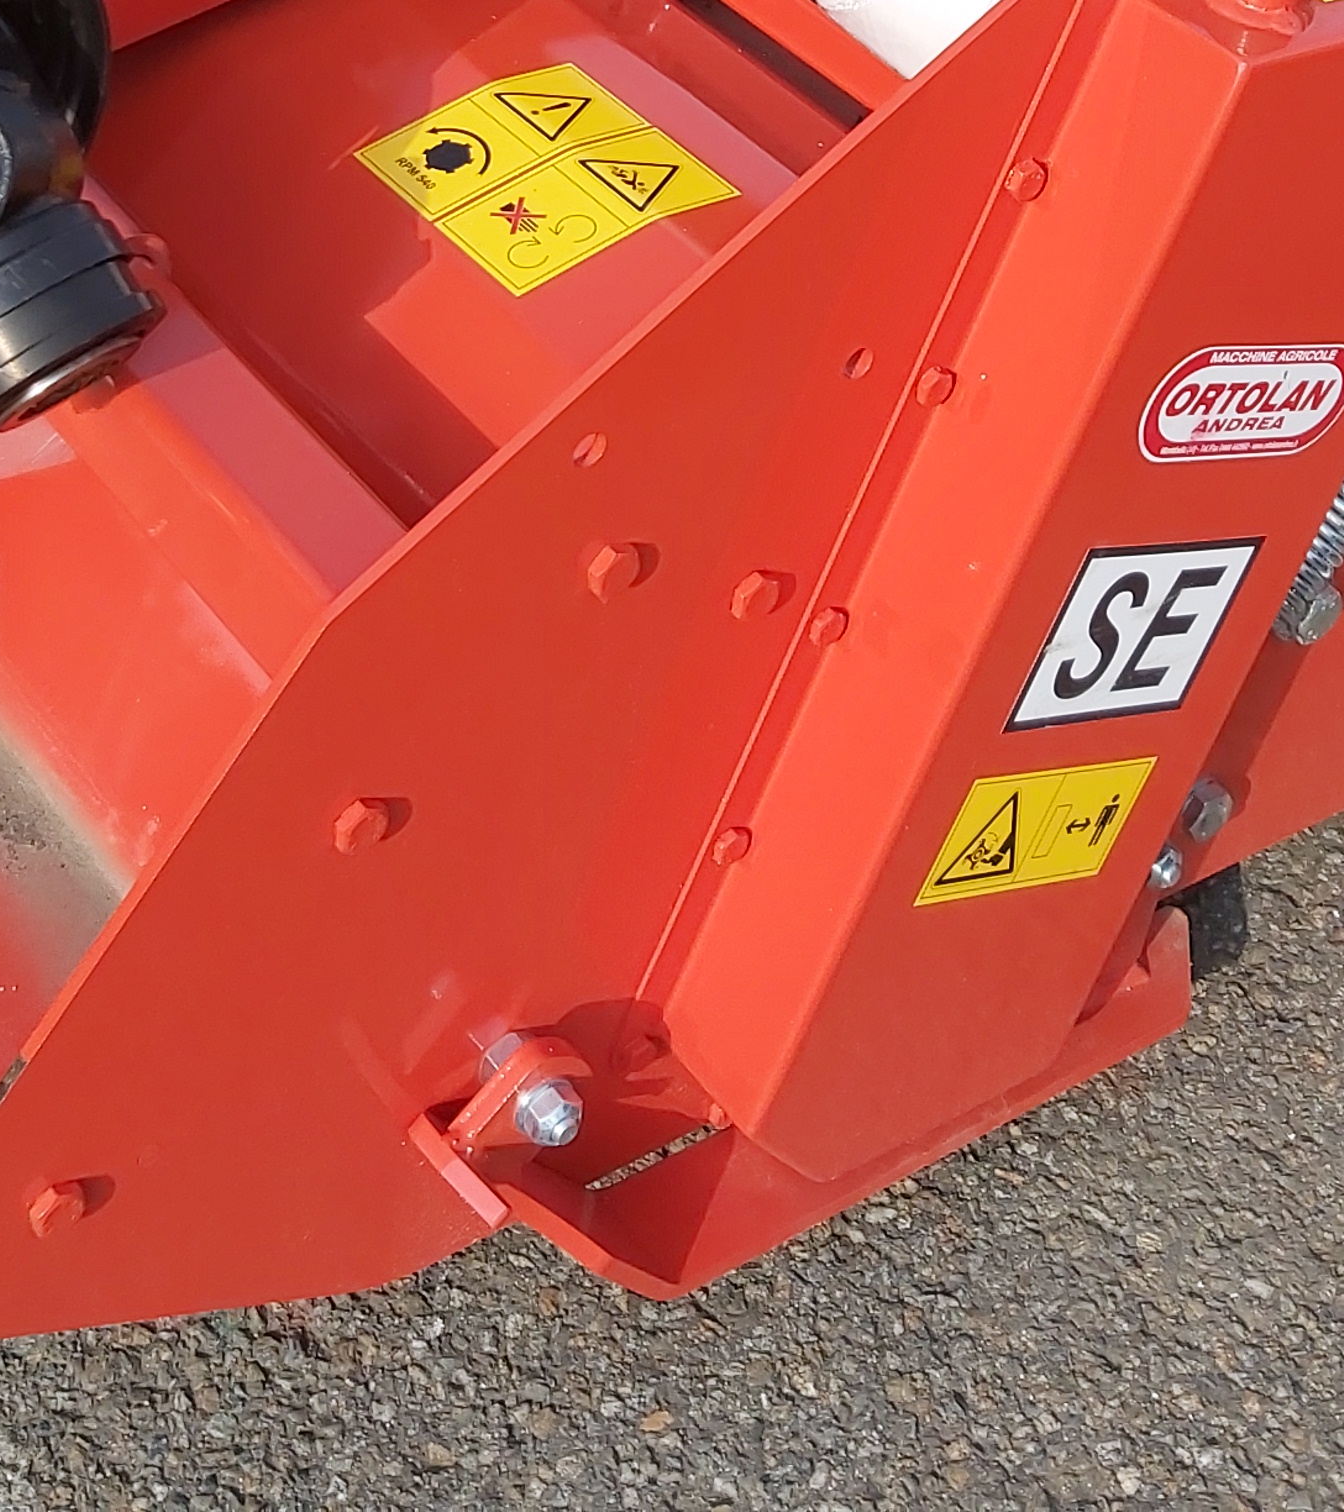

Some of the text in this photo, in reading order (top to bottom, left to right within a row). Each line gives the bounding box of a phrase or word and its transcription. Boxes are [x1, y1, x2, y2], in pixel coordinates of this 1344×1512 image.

[394, 157, 421, 177] RPM
[1209, 349, 1338, 364] MACCHINE AGRICOLE
[1165, 378, 1337, 417] ORTOLAN
[1192, 415, 1286, 434] ANDREA
[1052, 565, 1229, 700] SE
